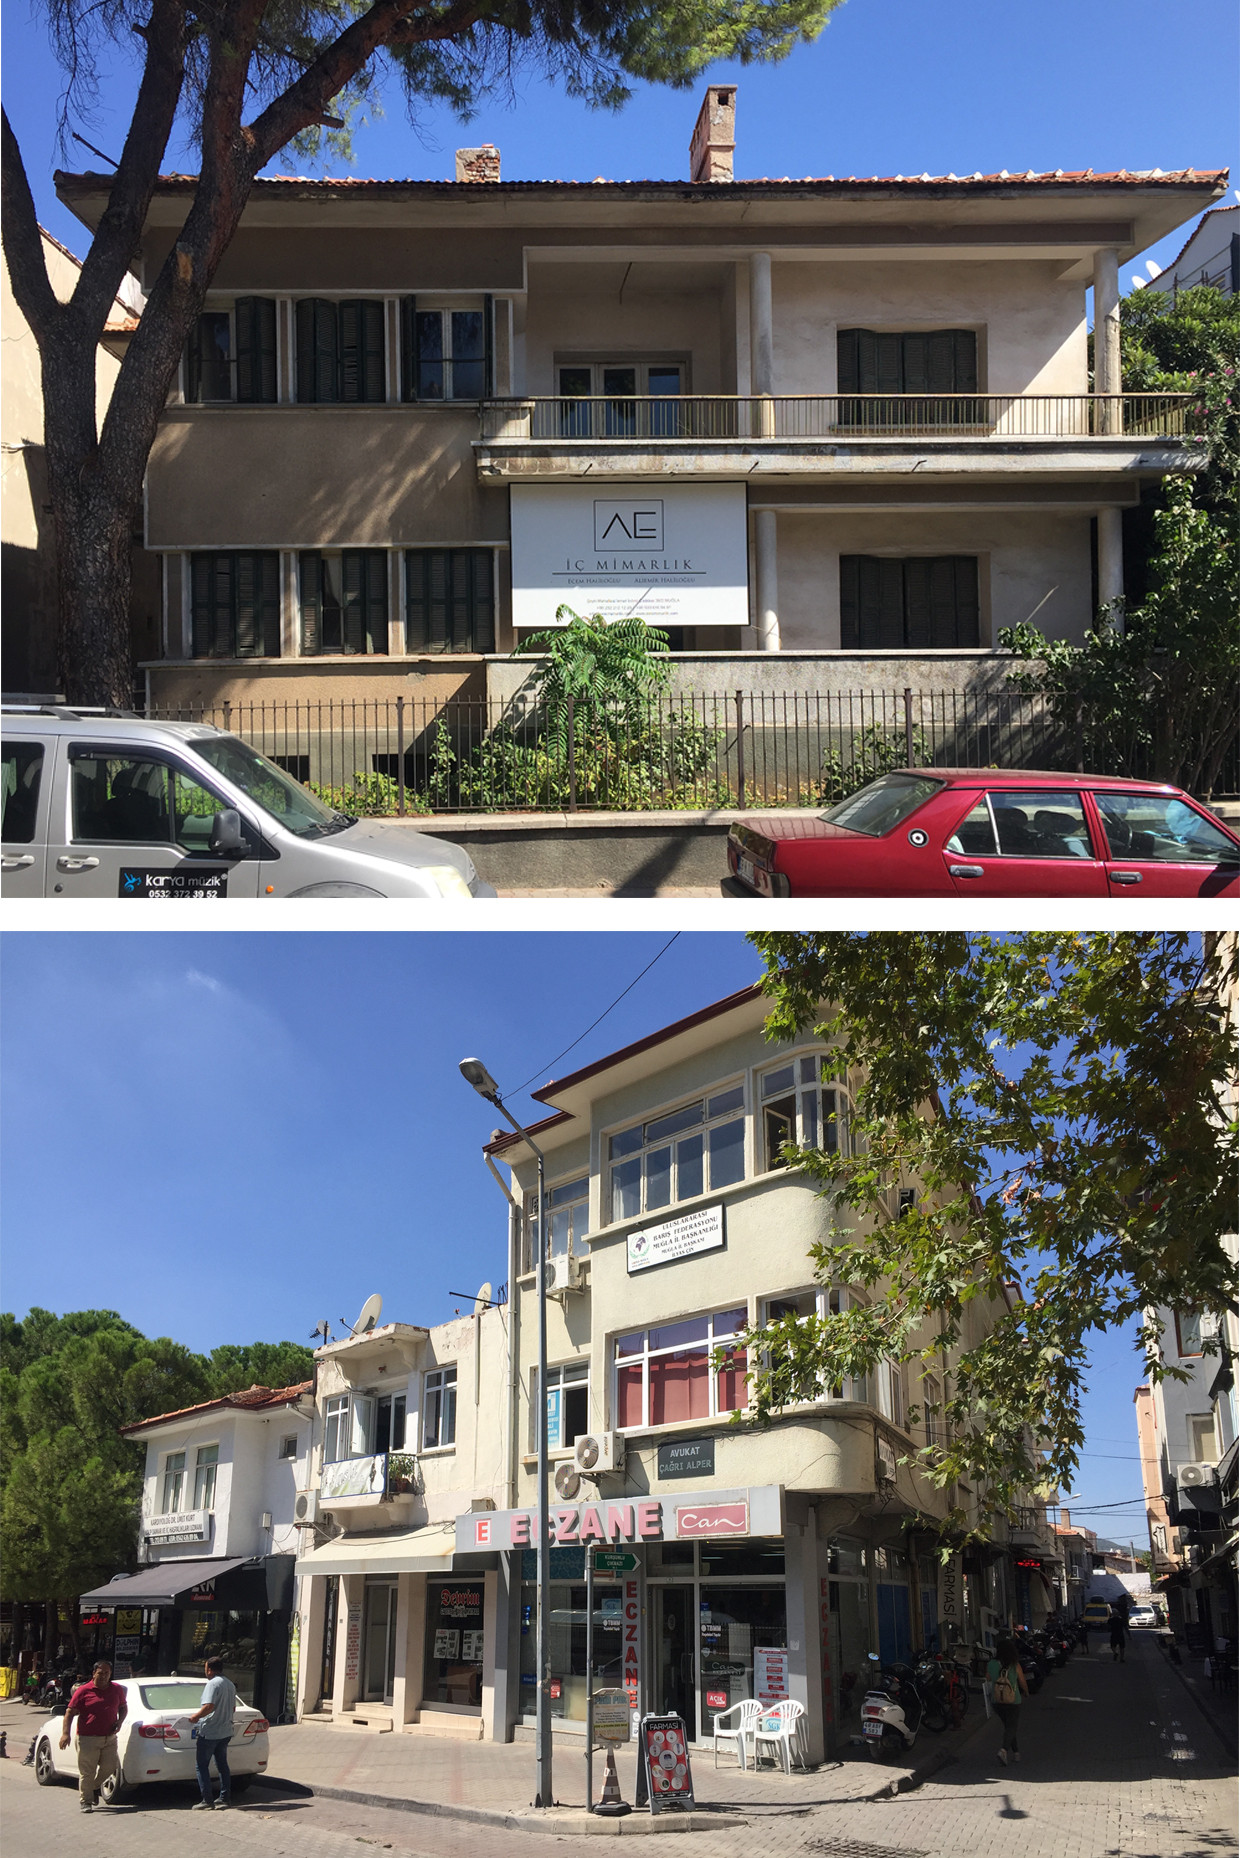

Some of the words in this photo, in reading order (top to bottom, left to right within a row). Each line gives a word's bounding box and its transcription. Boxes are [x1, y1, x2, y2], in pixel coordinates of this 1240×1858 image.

[566, 558, 585, 572] İÇ
[596, 557, 693, 571] MİMARLIK
[145, 874, 185, 886] karya
[188, 876, 221, 886] müzik
[148, 890, 171, 898] 0532
[173, 890, 190, 898] 372
[206, 890, 218, 898] 52
[653, 1231, 671, 1241] BARIŞ
[673, 1216, 718, 1235] FEDERASYONU
[662, 1211, 708, 1231] ULUSLARARASI
[653, 1238, 673, 1250] MUĞLA
[681, 1223, 719, 1241] BAŞKANLIĞI
[669, 1446, 701, 1458] AVUKAT
[659, 1461, 683, 1474] ÇAĞRI
[686, 1459, 712, 1470] ALPER
[680, 1513, 746, 1529] Can
[440, 1588, 480, 1607] Devrim
[625, 1581, 638, 1708] ECZANE
[820, 1577, 835, 1723] ECZANE
[649, 1722, 679, 1731] FARMASİ
